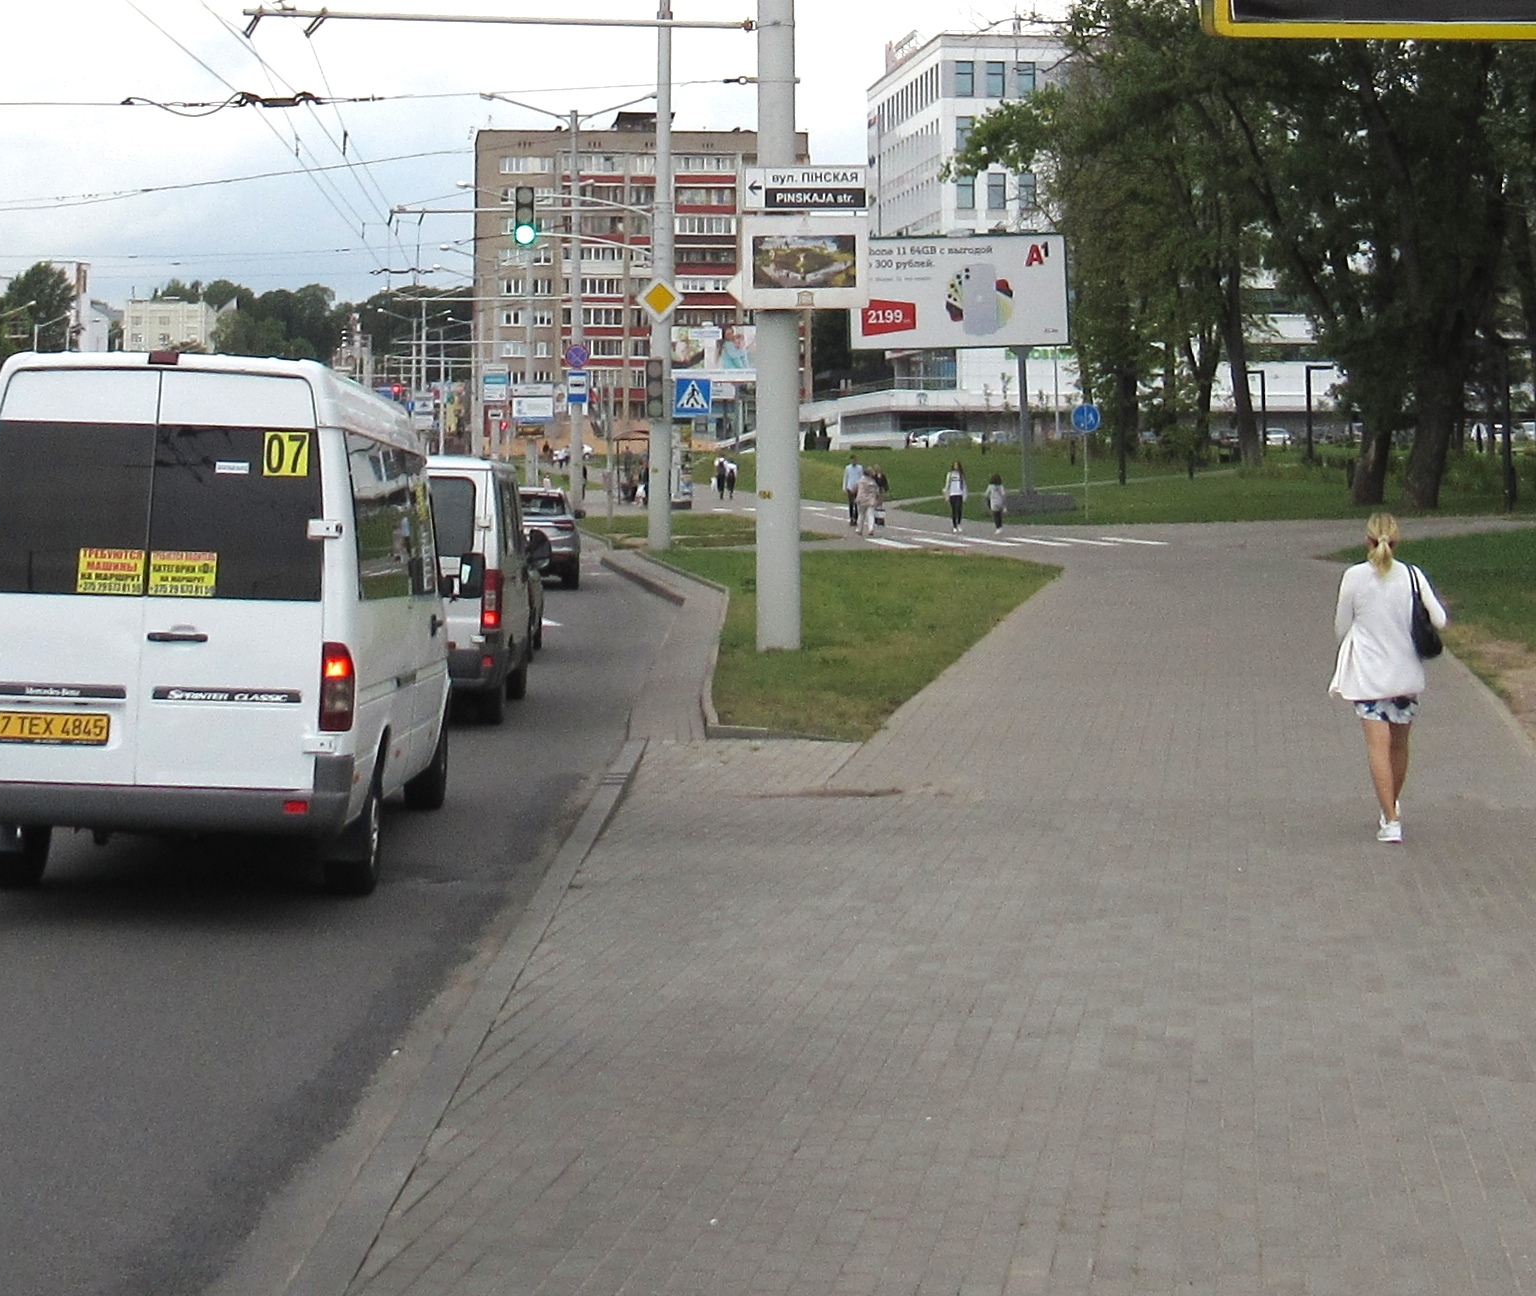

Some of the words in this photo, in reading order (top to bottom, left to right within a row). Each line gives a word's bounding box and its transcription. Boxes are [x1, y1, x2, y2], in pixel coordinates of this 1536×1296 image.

[772, 174, 798, 185] вул.
[801, 172, 859, 183] ПІНСКАЯ
[775, 192, 835, 204] PINSKAJA
[836, 193, 855, 203] str.
[868, 246, 893, 255] hone
[897, 246, 906, 255] 11
[1025, 241, 1049, 267] A1
[875, 259, 893, 269] 300
[867, 309, 904, 324] 2199
[266, 434, 307, 474] 07
[0, 715, 12, 734] 7
[18, 716, 54, 735] TEX
[61, 717, 105, 737] 4845
